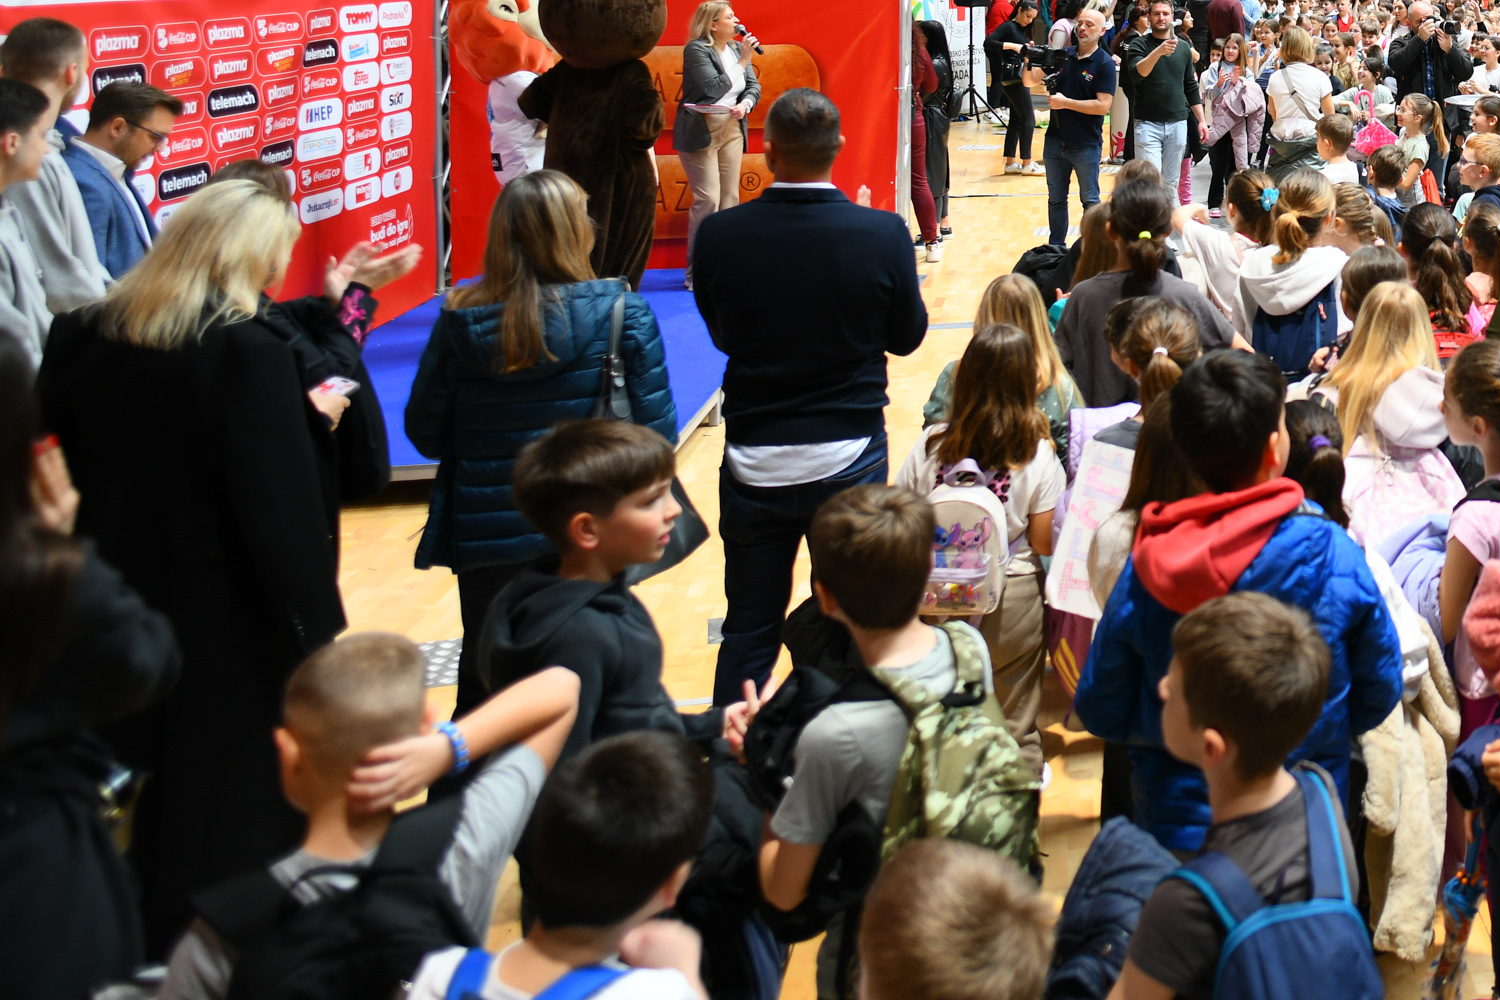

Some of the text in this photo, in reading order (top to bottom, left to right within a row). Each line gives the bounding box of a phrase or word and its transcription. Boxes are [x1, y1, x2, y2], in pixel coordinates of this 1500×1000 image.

[310, 15, 332, 33] plazma
[346, 11, 373, 26] TOMMY
[383, 12, 405, 21] Podravka
[208, 25, 245, 45] plazma
[287, 22, 300, 32] CUP
[186, 32, 197, 44] CUP
[383, 37, 407, 52] plazma
[95, 37, 140, 57] plazma
[305, 46, 336, 62] telemach
[267, 48, 295, 65] plazma
[165, 60, 194, 79] plazma
[213, 60, 248, 79] plazma
[326, 77, 338, 87] CUP
[211, 91, 256, 111] telemach
[268, 83, 295, 104] plazma
[314, 105, 333, 122] HEP
[348, 98, 375, 116] plazma
[287, 116, 296, 126] CUP
[217, 126, 255, 147] plazma
[369, 128, 377, 138] CUP
[191, 137, 204, 149] CUP
[385, 147, 409, 165] plazma
[331, 167, 341, 178] CUP
[162, 169, 208, 194] telemach
[370, 219, 409, 243] budi dio igre
